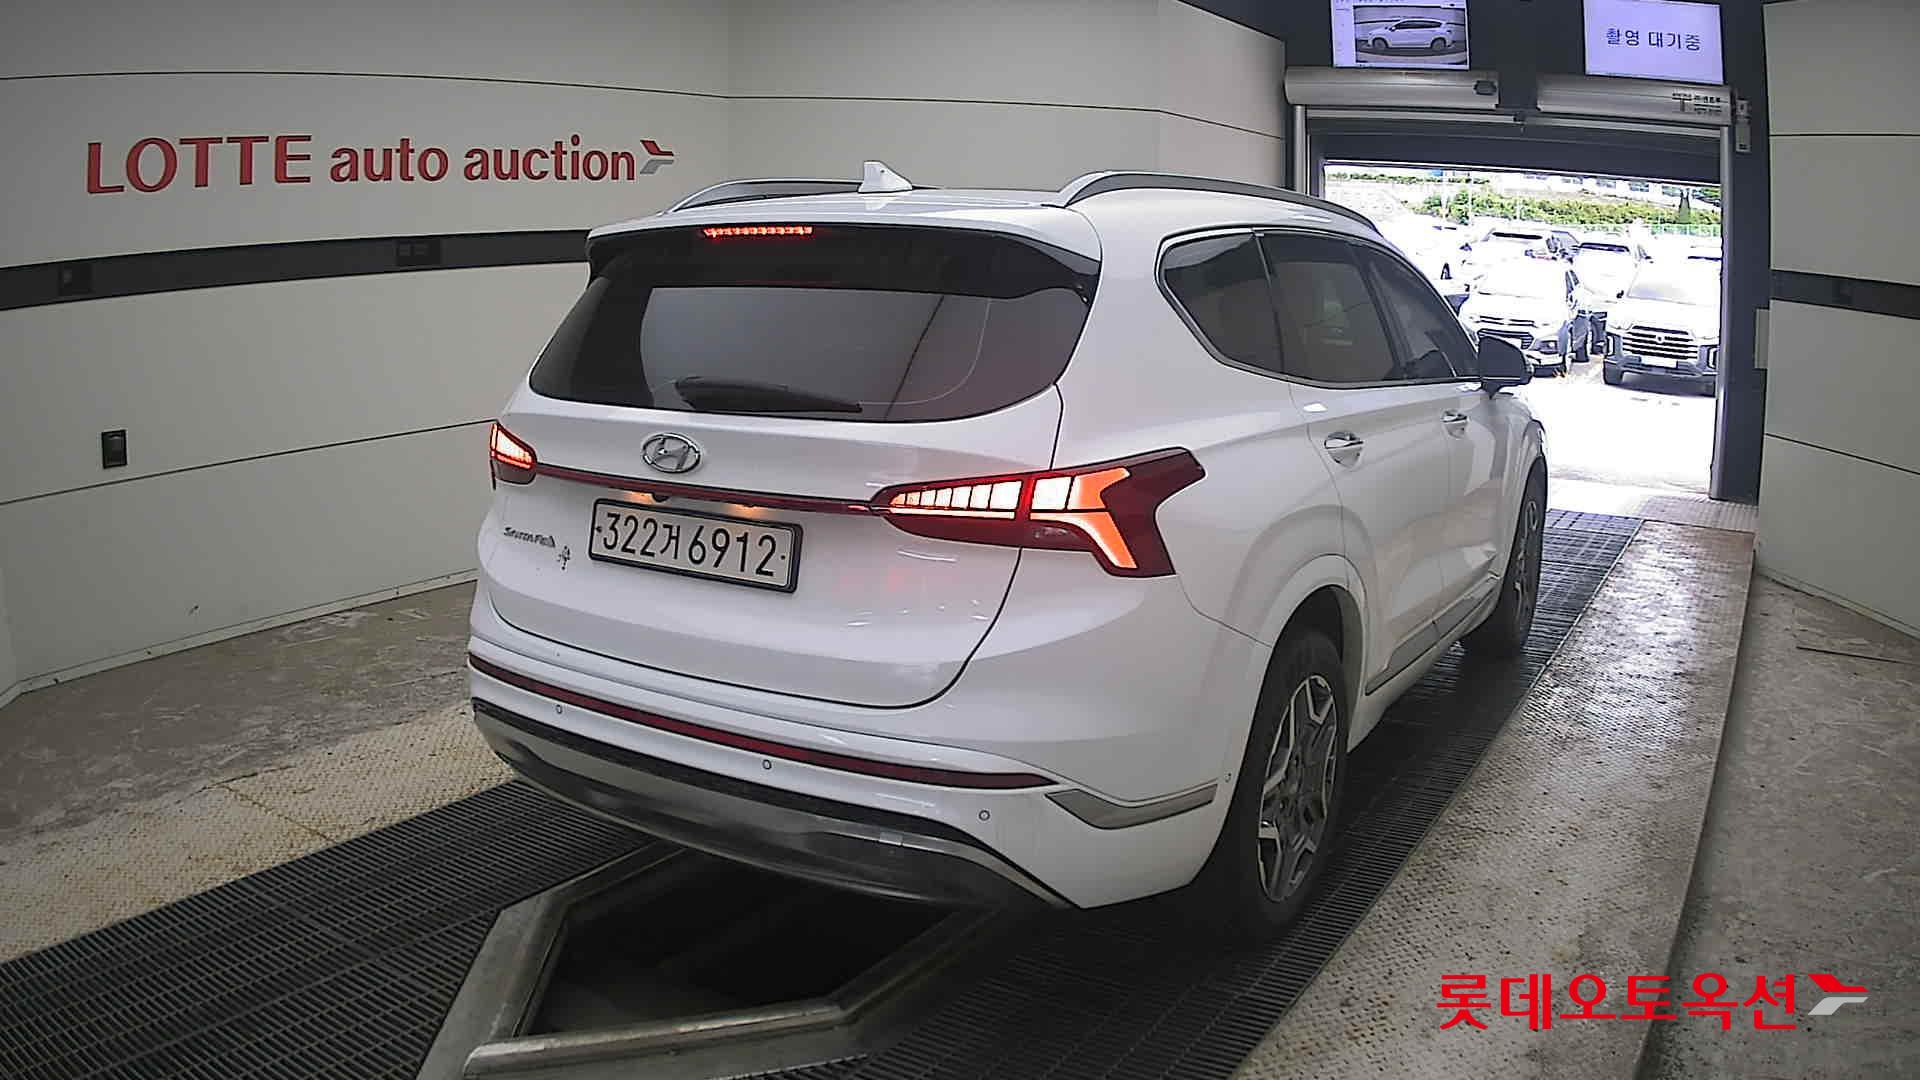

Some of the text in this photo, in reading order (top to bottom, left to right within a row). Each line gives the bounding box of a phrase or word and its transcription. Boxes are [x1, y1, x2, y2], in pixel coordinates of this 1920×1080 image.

[1647, 31, 1702, 52] 대기중
[86, 133, 636, 195] LOTTE auto auction
